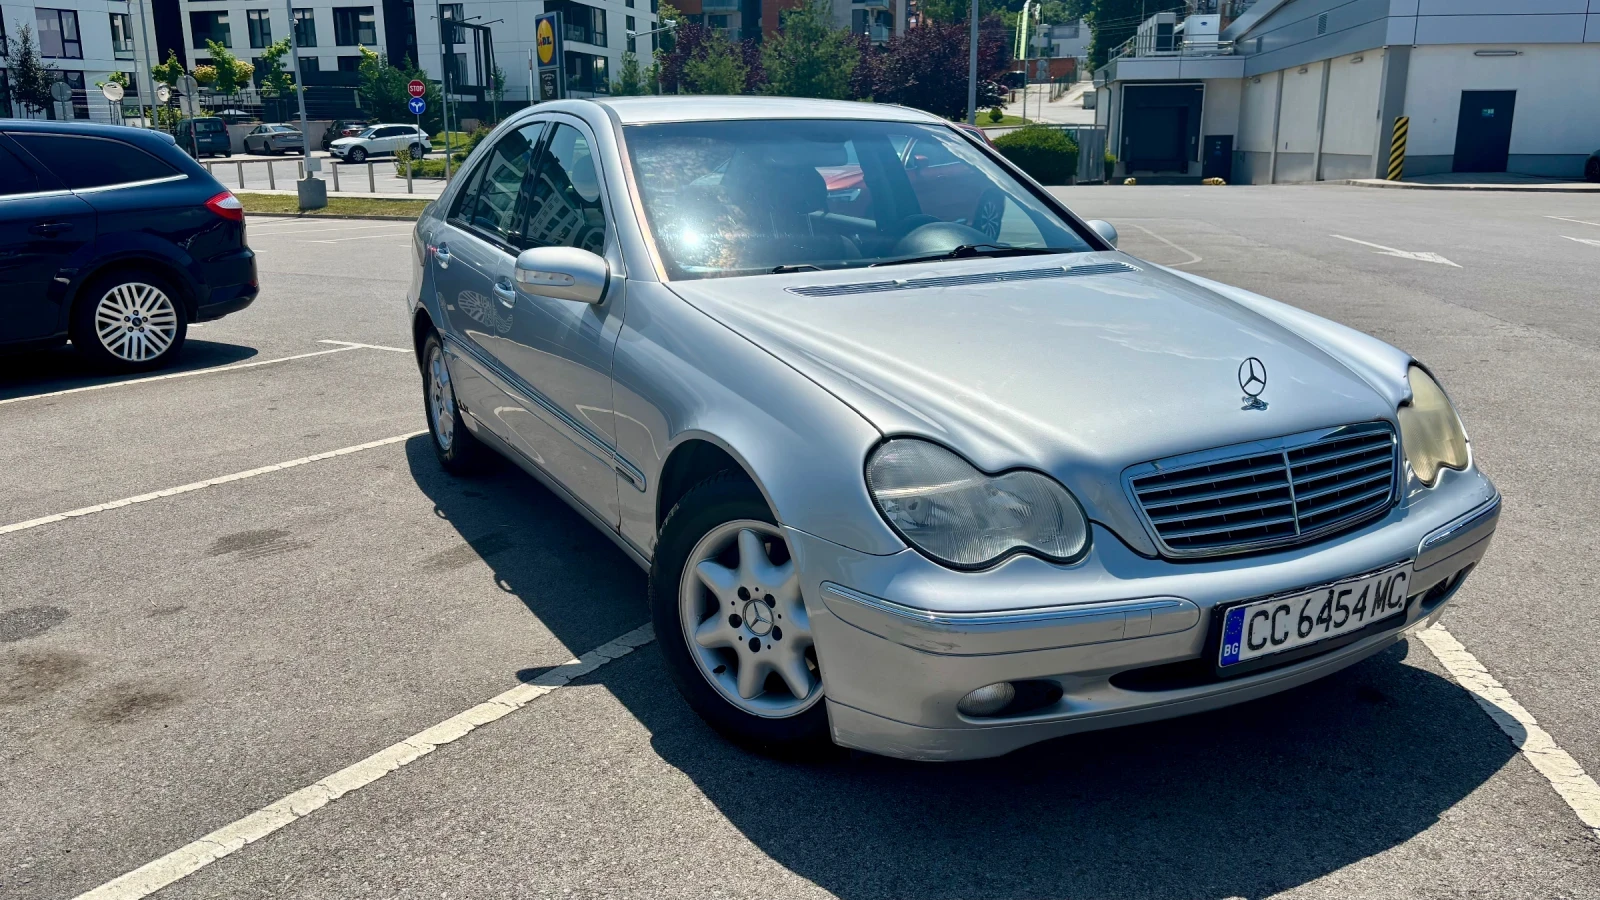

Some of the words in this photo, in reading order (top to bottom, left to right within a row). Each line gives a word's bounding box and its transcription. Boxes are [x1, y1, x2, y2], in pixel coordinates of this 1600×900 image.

[1247, 604, 1291, 651] CC
[1297, 584, 1370, 638] 6454
[1370, 572, 1407, 617] MC
[1223, 642, 1239, 657] BG
